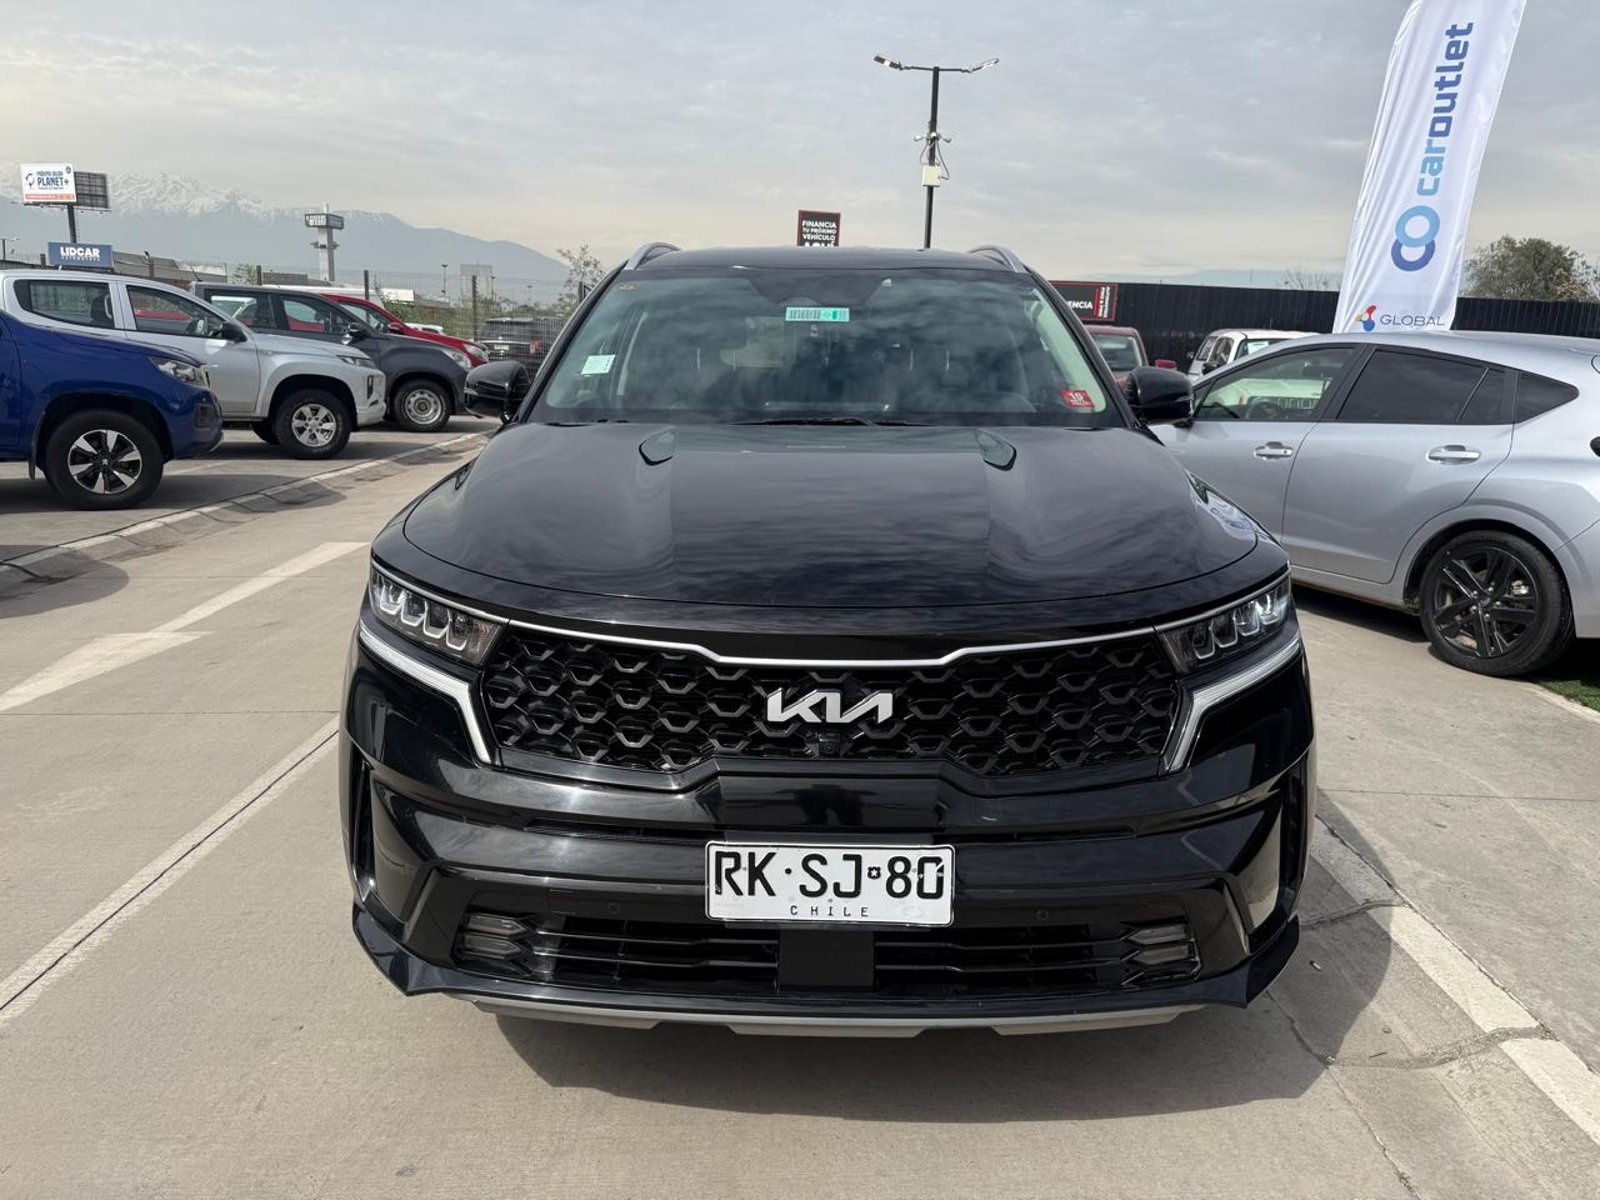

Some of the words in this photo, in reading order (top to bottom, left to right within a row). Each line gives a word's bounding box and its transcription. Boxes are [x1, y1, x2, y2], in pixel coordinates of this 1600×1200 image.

[1416, 22, 1474, 197] caroutlet
[802, 220, 837, 228] FINANCIA
[60, 246, 100, 258] LIDCAR
[1380, 314, 1446, 327] GLOBAL
[766, 687, 893, 724] KIA
[790, 905, 869, 917] CHILE
